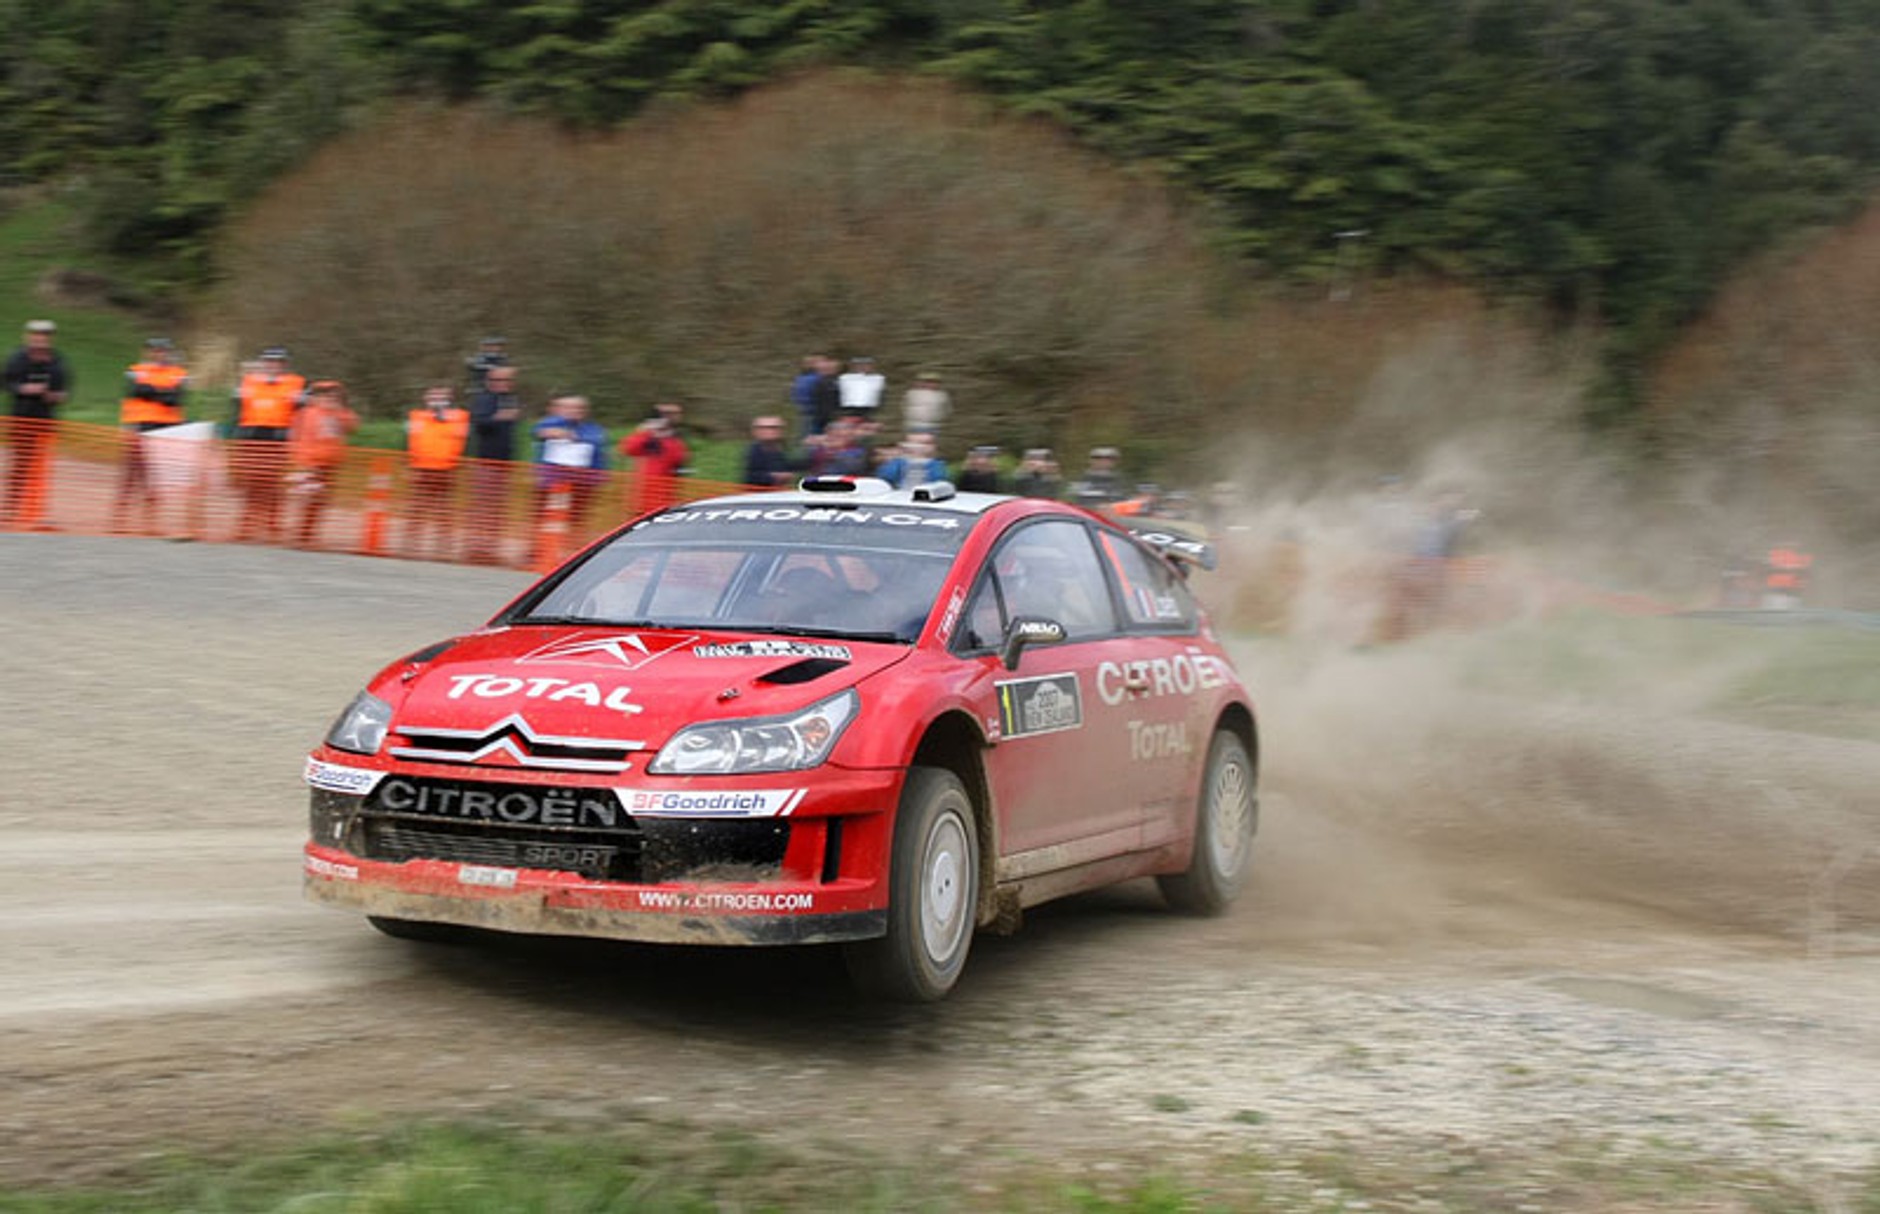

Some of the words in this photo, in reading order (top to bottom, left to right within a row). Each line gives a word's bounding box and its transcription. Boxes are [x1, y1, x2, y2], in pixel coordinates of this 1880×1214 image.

[881, 514, 959, 529] C4
[447, 674, 643, 714] TOTAL
[1127, 721, 1192, 760] TOTAL
[379, 780, 617, 827] CITROËN
[632, 793, 766, 809] BFGoodrich
[524, 847, 617, 868] SPORT
